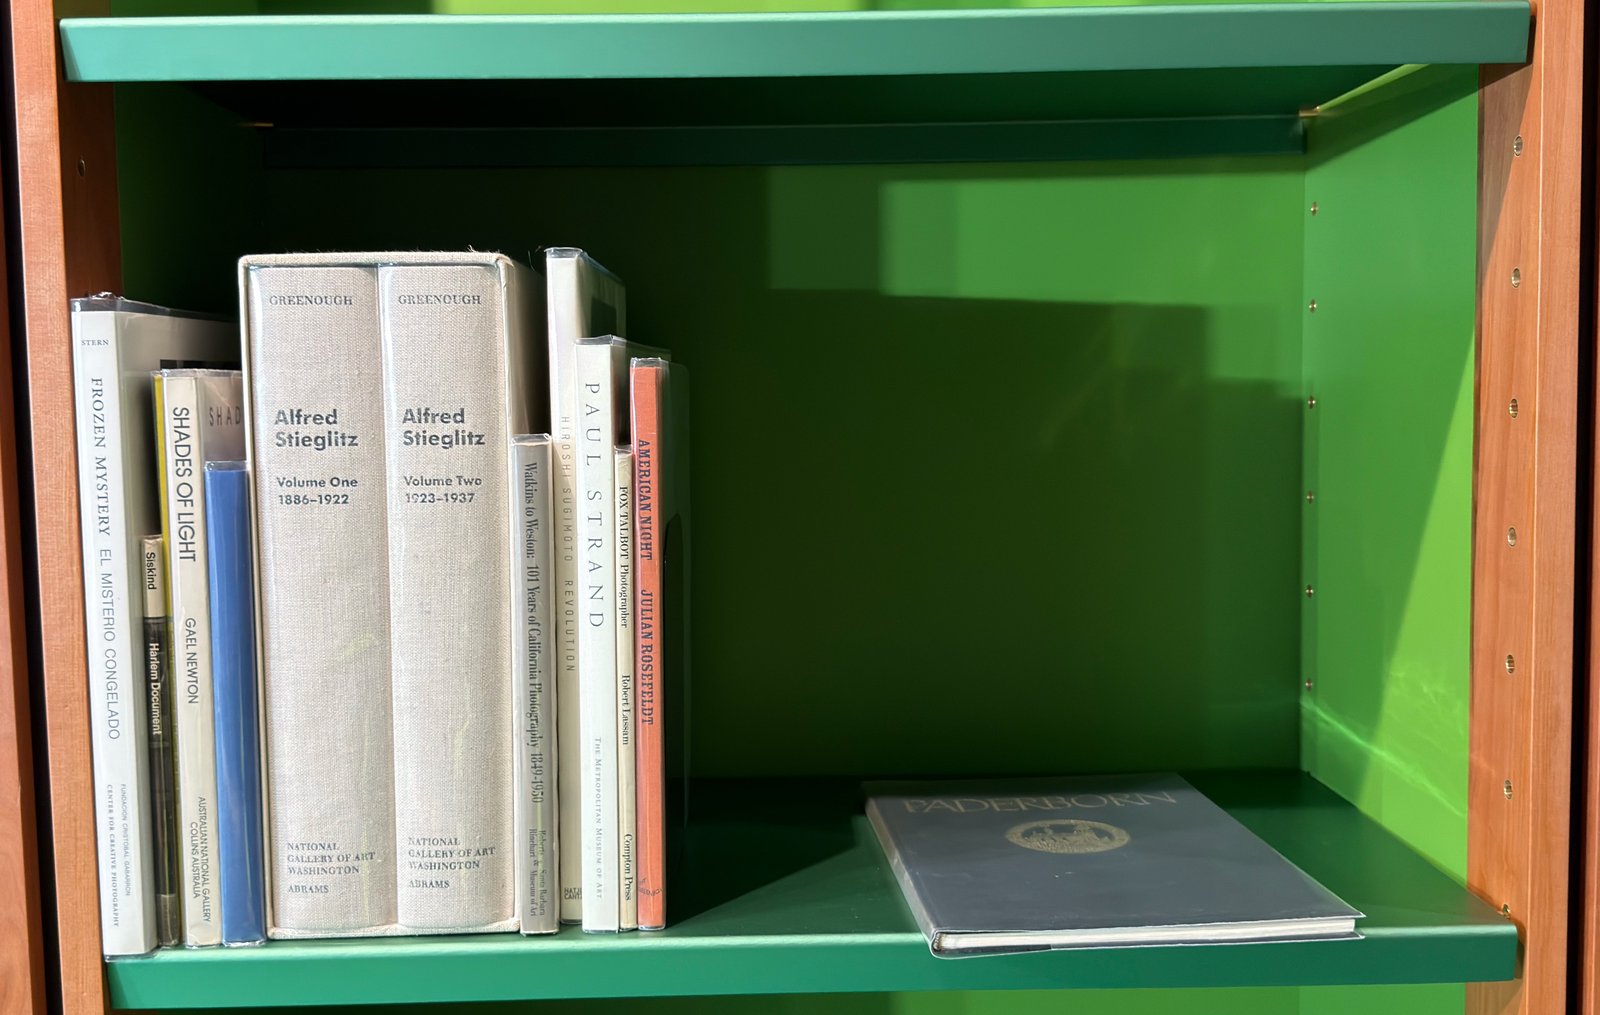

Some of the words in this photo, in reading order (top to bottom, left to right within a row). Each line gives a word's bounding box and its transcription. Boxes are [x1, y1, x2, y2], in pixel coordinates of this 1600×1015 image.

[270, 296, 352, 306] GREENOUGH
[398, 295, 482, 304] GREENOUGH
[92, 378, 106, 448] FROZEN
[209, 406, 241, 426] SHAD
[275, 408, 338, 425] Alfred
[402, 408, 465, 424] Alfred
[586, 384, 601, 466] PAUL
[172, 407, 192, 478] SHADES
[275, 430, 358, 450] Stieglitz
[403, 430, 486, 449] Stieglitz
[561, 416, 572, 478] HIROSHI
[277, 477, 326, 488] Volume
[330, 477, 358, 488] One
[404, 476, 452, 486] Volume
[456, 476, 482, 486] Two
[524, 462, 538, 504] Watkins
[638, 440, 651, 515] AMERICAN
[96, 458, 110, 536] MYSTERY
[176, 482, 194, 508] OF
[525, 506, 538, 516] to
[619, 486, 629, 510] FOX
[178, 512, 196, 562] LIGHT
[525, 519, 539, 559] Weston:
[562, 488, 573, 562] SUGIMOTO
[620, 512, 629, 559] TALBOT
[639, 516, 652, 560] NIGHT
[100, 550, 112, 566] EL
[146, 552, 156, 590] Siskind
[527, 565, 539, 582] 101
[586, 490, 604, 627] STRAND
[102, 573, 116, 642] MISTERIO
[527, 586, 540, 613] Years
[619, 564, 629, 628] Photographer
[528, 616, 540, 626] of
[564, 580, 575, 671] REVOLUTION
[641, 590, 653, 640] JULIAN
[185, 618, 196, 649] GAEL
[149, 643, 159, 680] Harlem
[528, 628, 541, 680] California
[104, 648, 120, 740] CONGELADO
[187, 652, 198, 703] NEWTON
[622, 675, 630, 705] Robert
[641, 644, 653, 725] ROSEFELDT
[151, 683, 162, 735] Document
[526, 682, 543, 748] Photography
[622, 708, 630, 745] Lassam
[904, 792, 1176, 814] PADERBORN
[199, 797, 208, 845] AUSTRALIAN
[190, 822, 199, 856] COLLINS
[288, 842, 339, 850] NATIONAL
[409, 838, 460, 846] NATIONAL
[409, 849, 455, 858] GALLERY
[458, 849, 472, 857] OF
[474, 847, 496, 857] ART
[622, 834, 632, 875] Compton
[201, 846, 209, 886] NATIONAL
[288, 854, 333, 863] GALLERY
[337, 854, 351, 862] OF
[354, 852, 376, 861] ART
[288, 866, 360, 875] WASHINGTON
[409, 861, 480, 870] WASHINGTON
[596, 868, 602, 879] OF
[192, 857, 202, 898] AUSTRALIA
[288, 885, 329, 894] ABRAMS
[409, 880, 450, 888] ABRAMS
[625, 877, 633, 900] Press
[202, 889, 211, 922] GALLERY
[539, 890, 547, 915] Barbara
